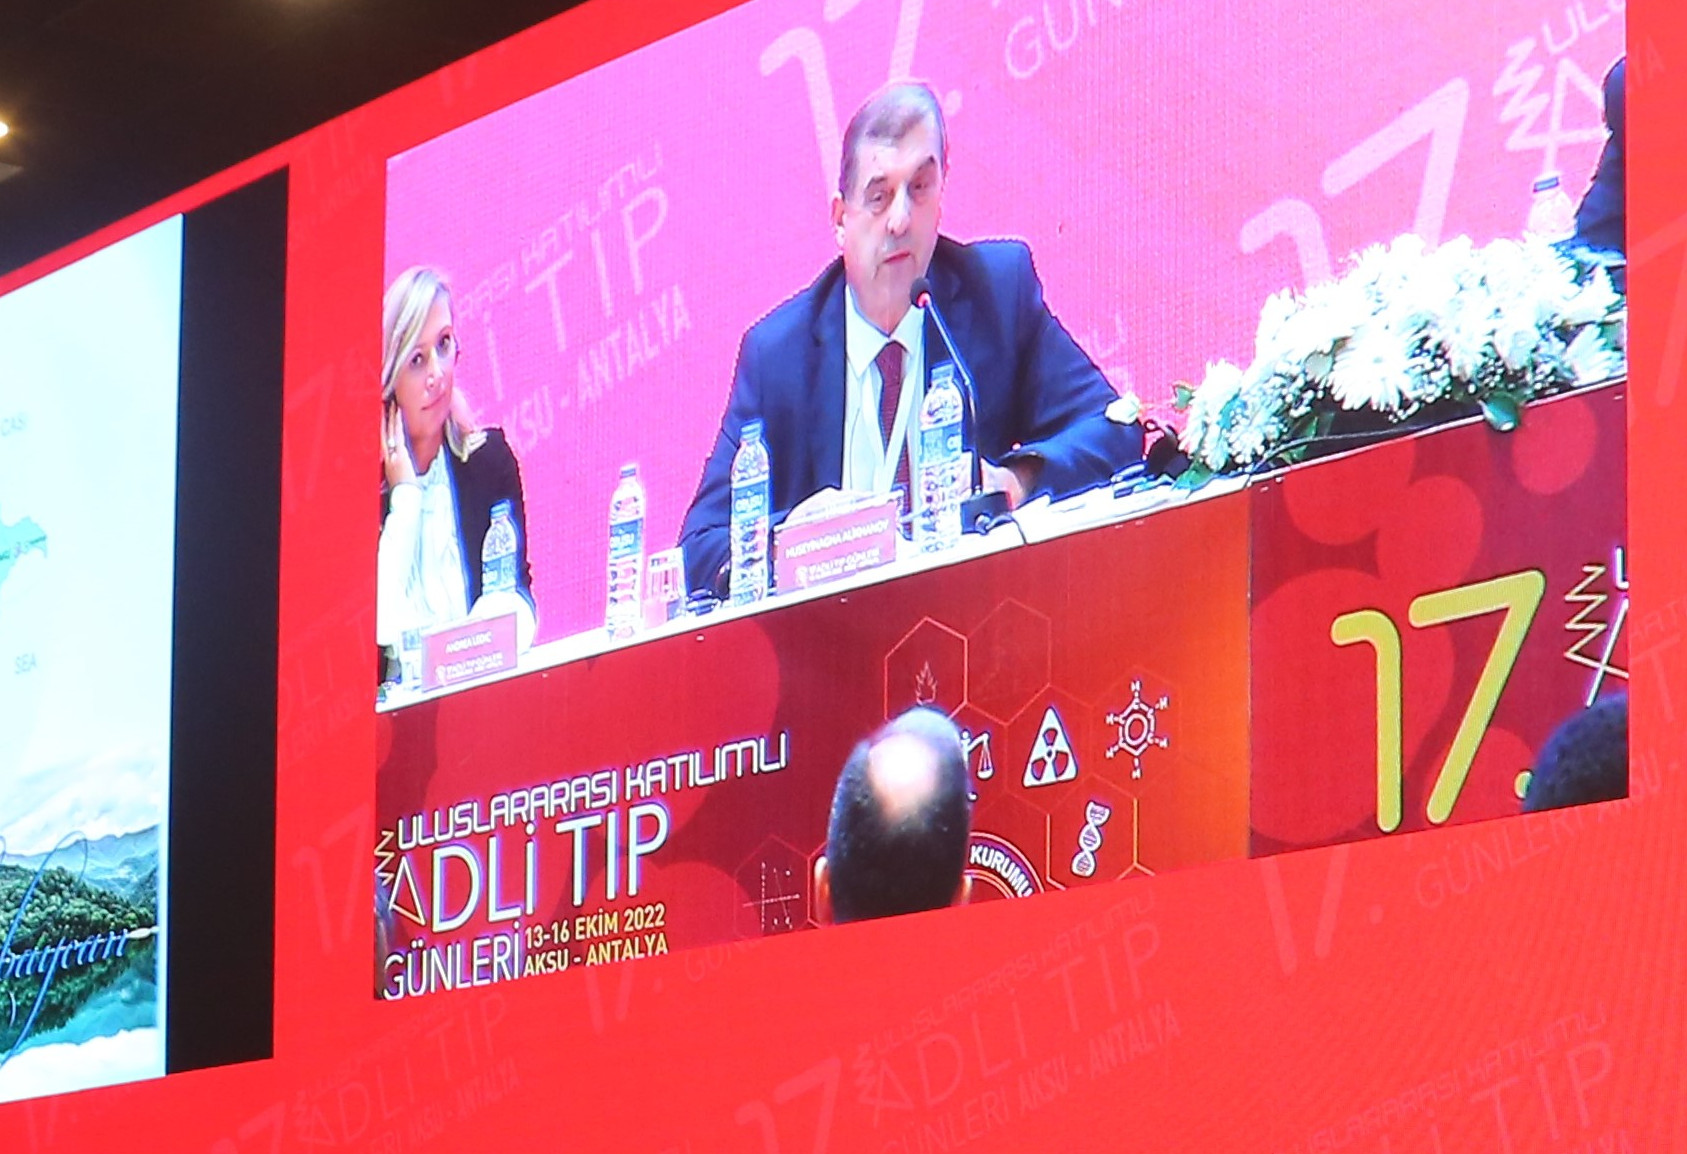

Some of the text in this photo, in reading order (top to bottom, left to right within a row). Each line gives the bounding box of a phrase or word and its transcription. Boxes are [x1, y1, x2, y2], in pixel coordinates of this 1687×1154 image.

[1330, 568, 1534, 833] 17.
[395, 733, 788, 850] ULUSLARARASI KATILIMLI
[375, 802, 671, 934] ADLİ TIP
[383, 923, 523, 1001] GÜNLERİ
[523, 949, 569, 979] AKSU
[585, 932, 671, 970] ANTALYA
[524, 903, 667, 951] 13-16 EKİM 2022
[1043, 921, 1161, 1033] TIP
